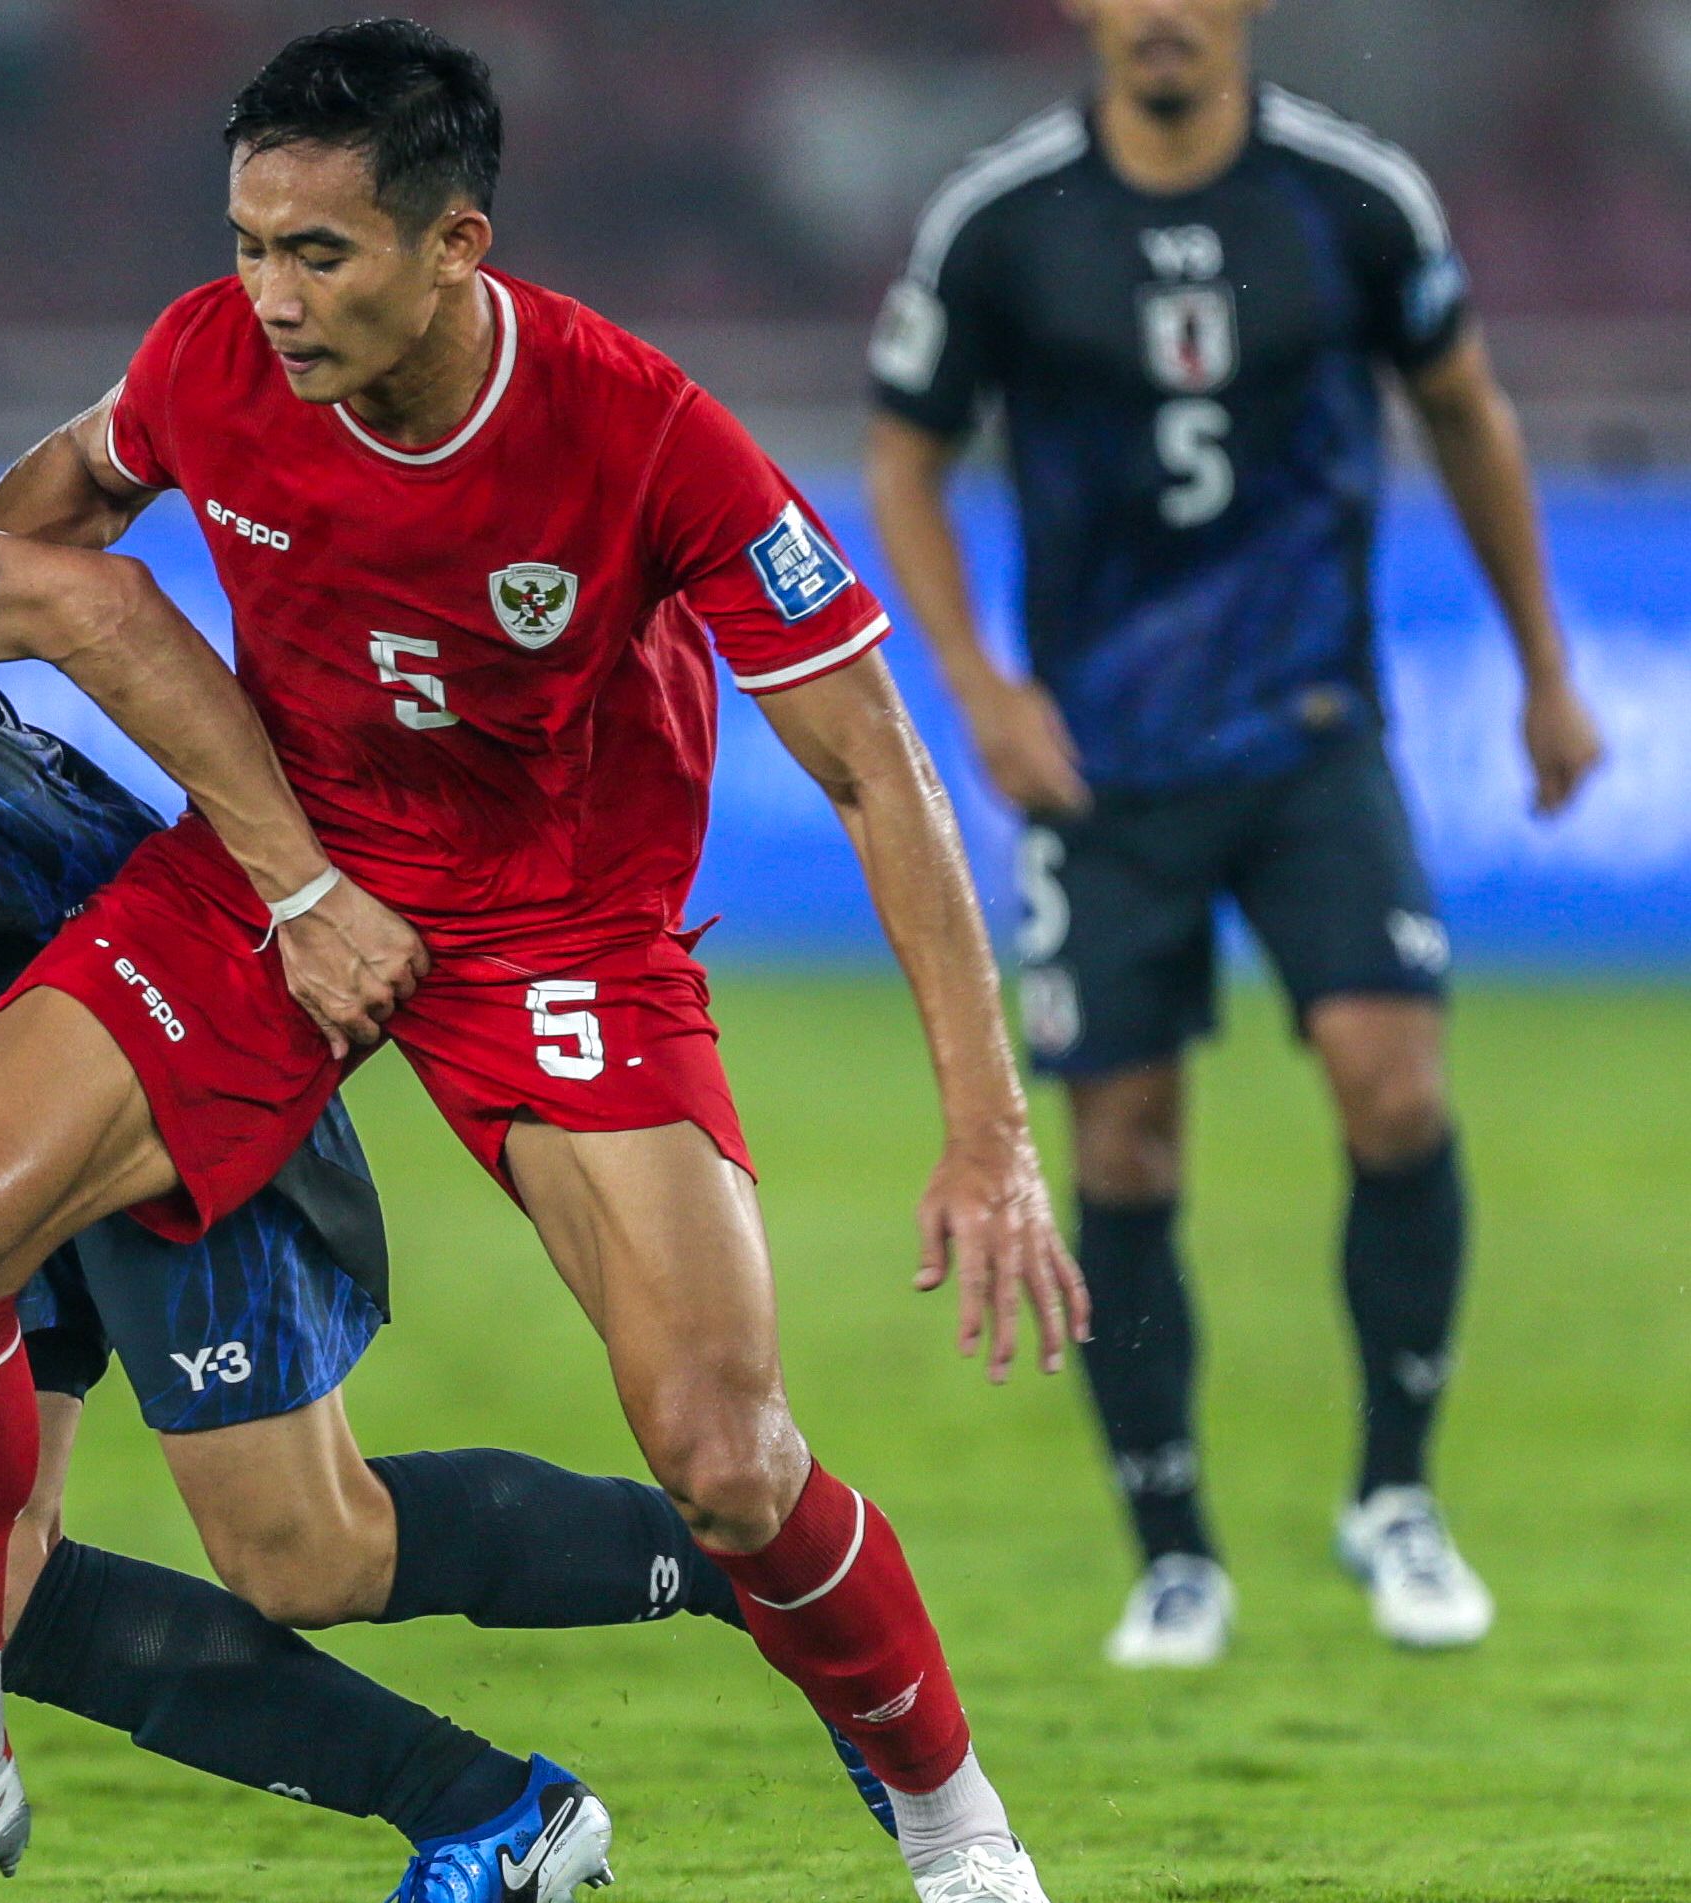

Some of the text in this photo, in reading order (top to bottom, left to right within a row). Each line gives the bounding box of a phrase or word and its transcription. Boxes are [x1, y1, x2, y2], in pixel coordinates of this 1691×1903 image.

[1154, 398, 1236, 530] 5
[206, 498, 292, 552] erspo
[368, 630, 461, 730] 5
[114, 956, 187, 1043] erspo
[524, 979, 606, 1082] 5
[170, 1340, 252, 1393] Y-3
